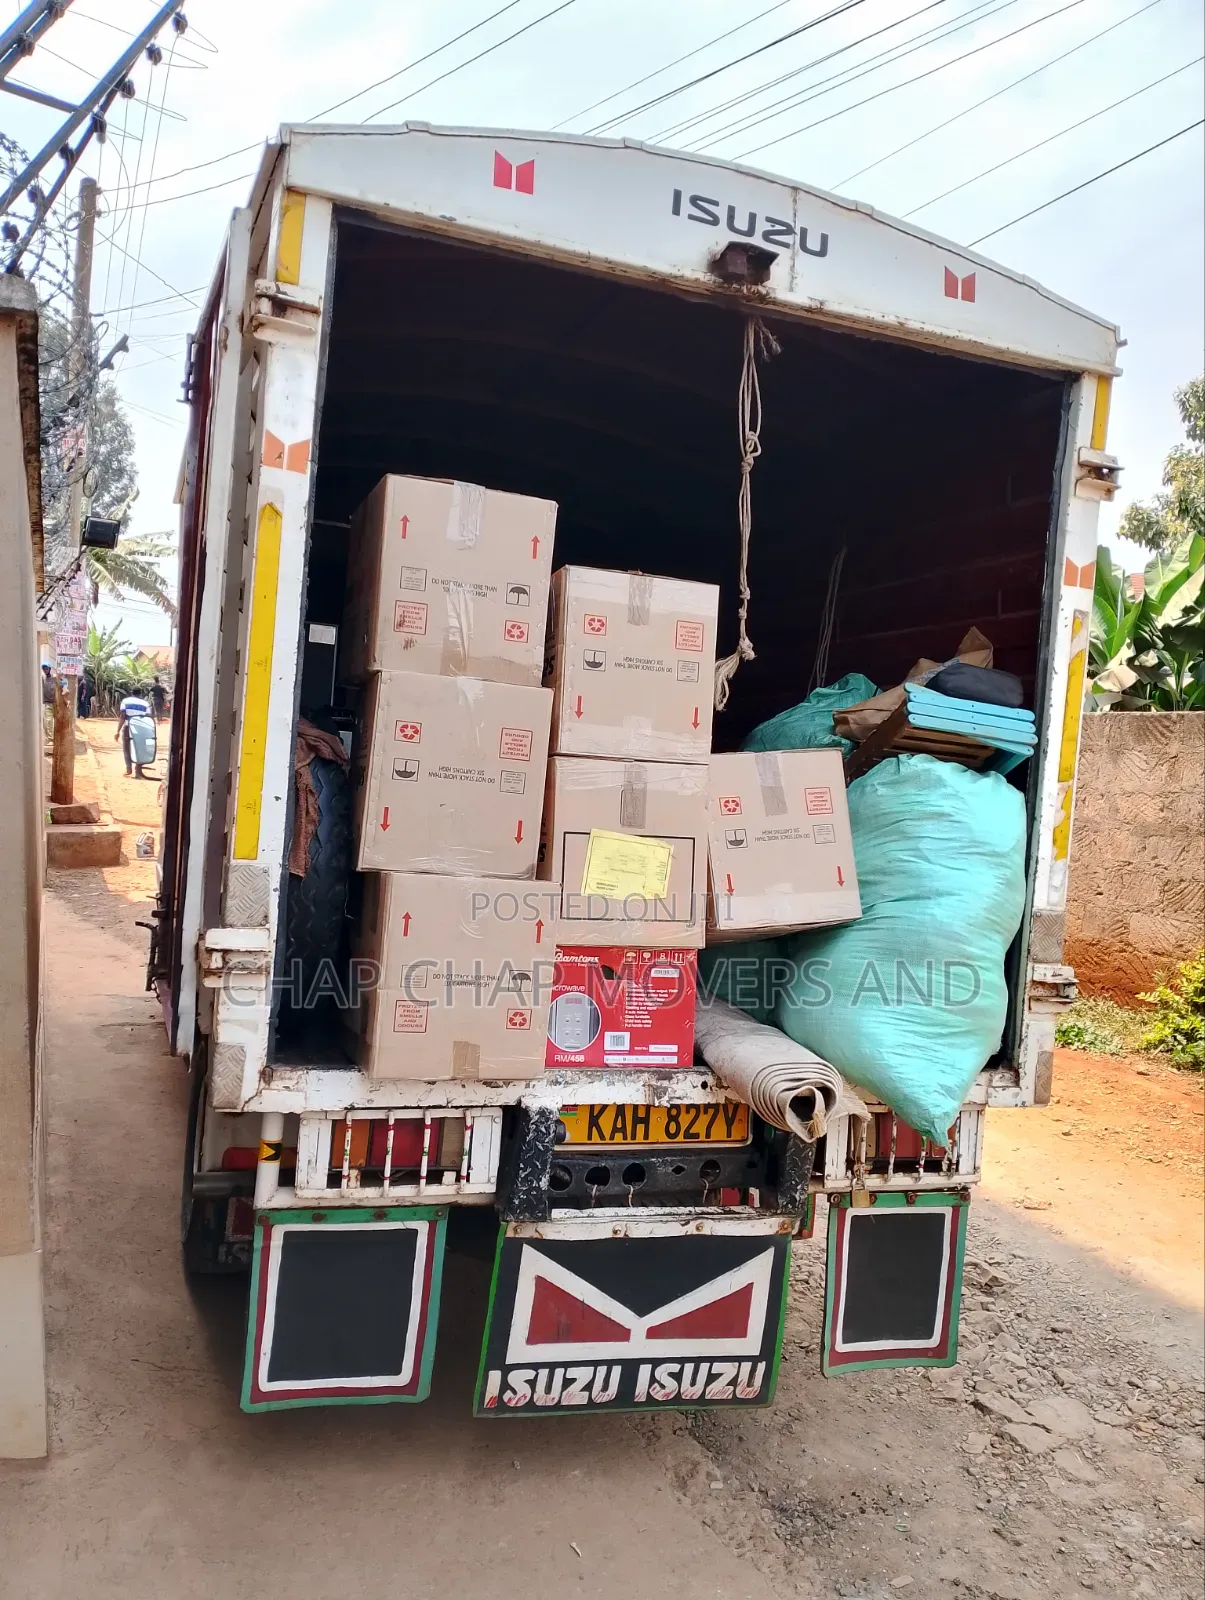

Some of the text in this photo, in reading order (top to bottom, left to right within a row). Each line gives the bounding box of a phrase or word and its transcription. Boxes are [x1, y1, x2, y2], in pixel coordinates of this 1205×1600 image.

[672, 188, 829, 258] ISUZU
[453, 767, 476, 775] CARTONS
[554, 1054, 584, 1062] RM/458
[587, 1104, 740, 1142] KAH 827Y
[484, 1360, 766, 1409] ISUZU ISUZU
